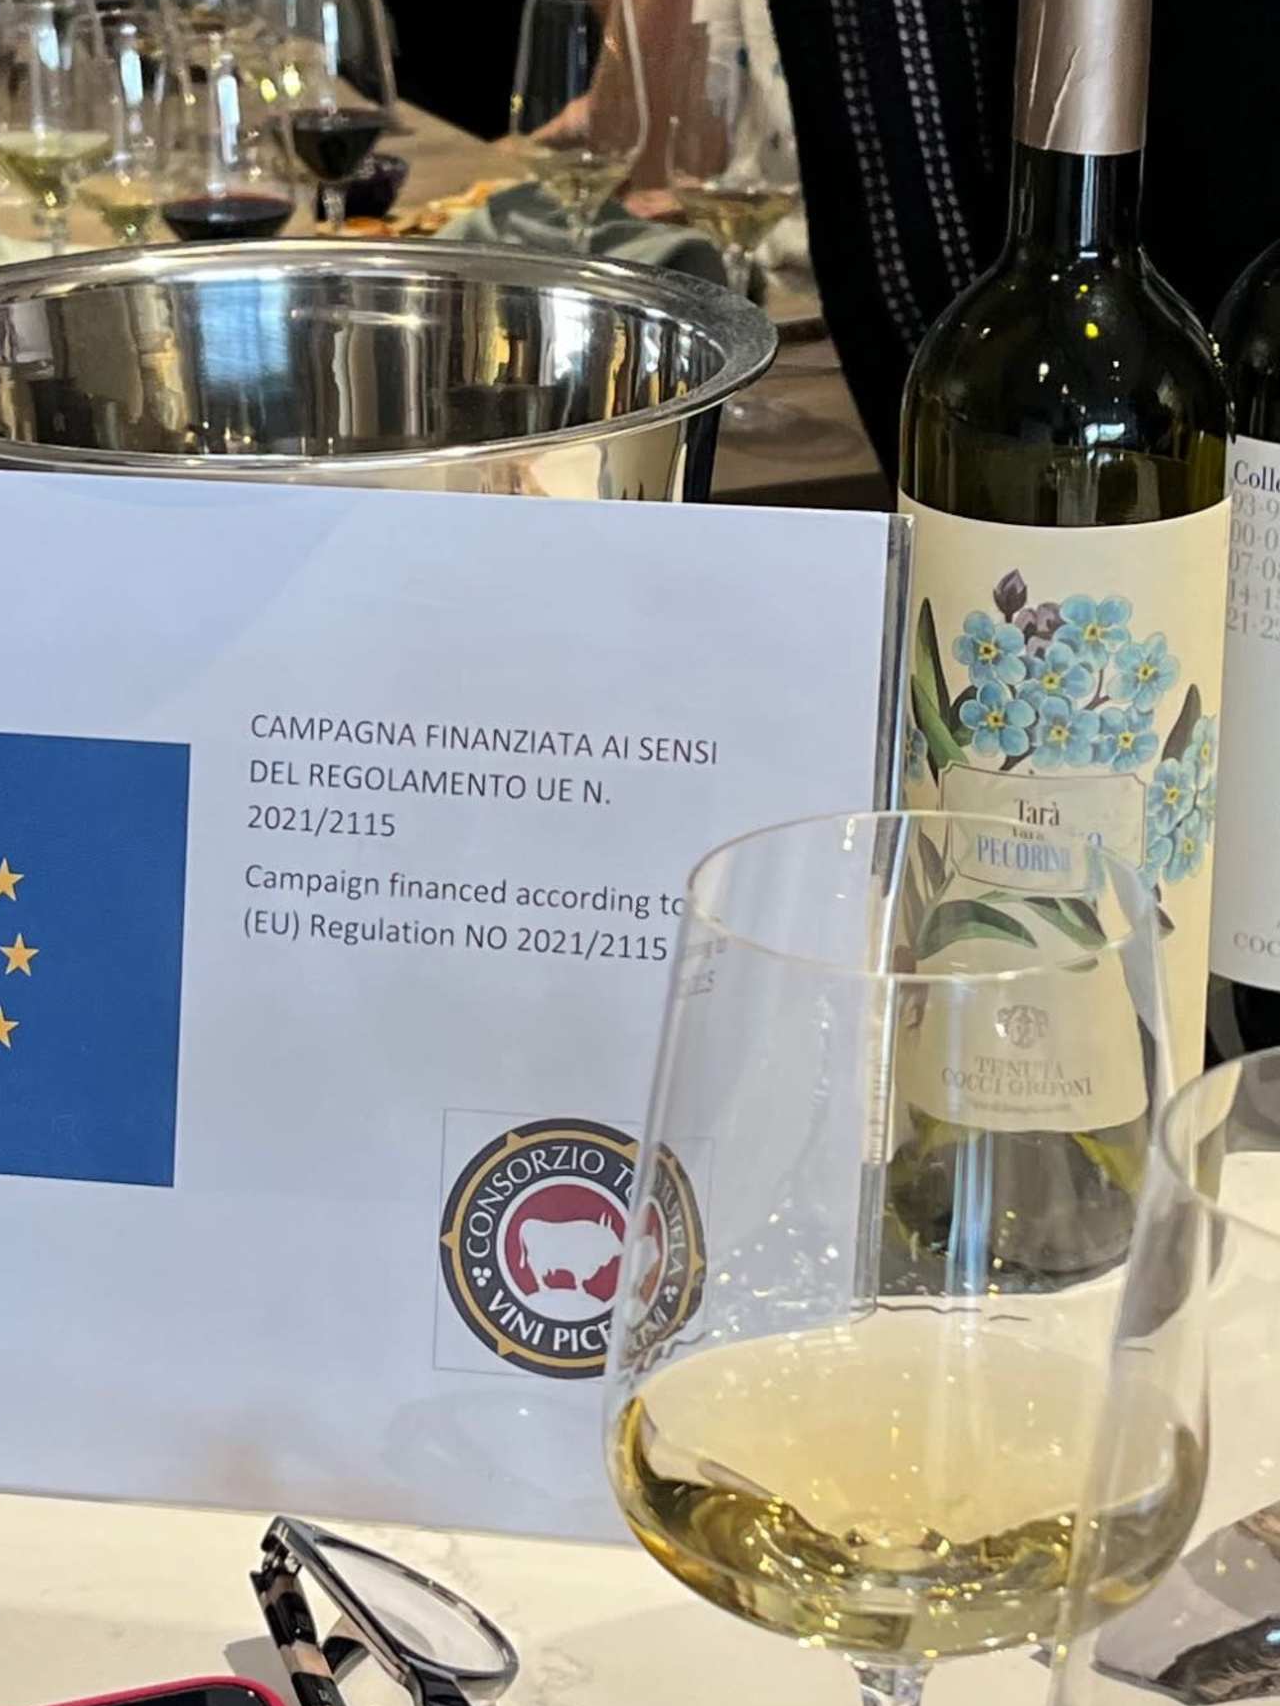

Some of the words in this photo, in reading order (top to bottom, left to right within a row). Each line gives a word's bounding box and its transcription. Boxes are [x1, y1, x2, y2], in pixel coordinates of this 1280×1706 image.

[250, 714, 417, 747] CAMPAGNA
[425, 724, 593, 758] FINANZIATA
[602, 735, 630, 760] AI
[639, 737, 719, 765] SENSI
[250, 759, 300, 786] DEL
[308, 762, 527, 799] REGOLAMENTO
[536, 776, 573, 802] UE
[582, 780, 612, 805] N.
[247, 805, 397, 838] 2021/2115
[1014, 798, 1060, 826] Tarà
[244, 864, 381, 902] Campaign
[388, 873, 508, 905] financed
[515, 882, 651, 920] according
[243, 909, 300, 940] (EU)
[310, 913, 456, 948] Regulation
[464, 925, 508, 951] NO
[517, 927, 669, 962] 2021/2115
[466, 1145, 606, 1259] CONSORZIO
[486, 1289, 546, 1346] VINI
